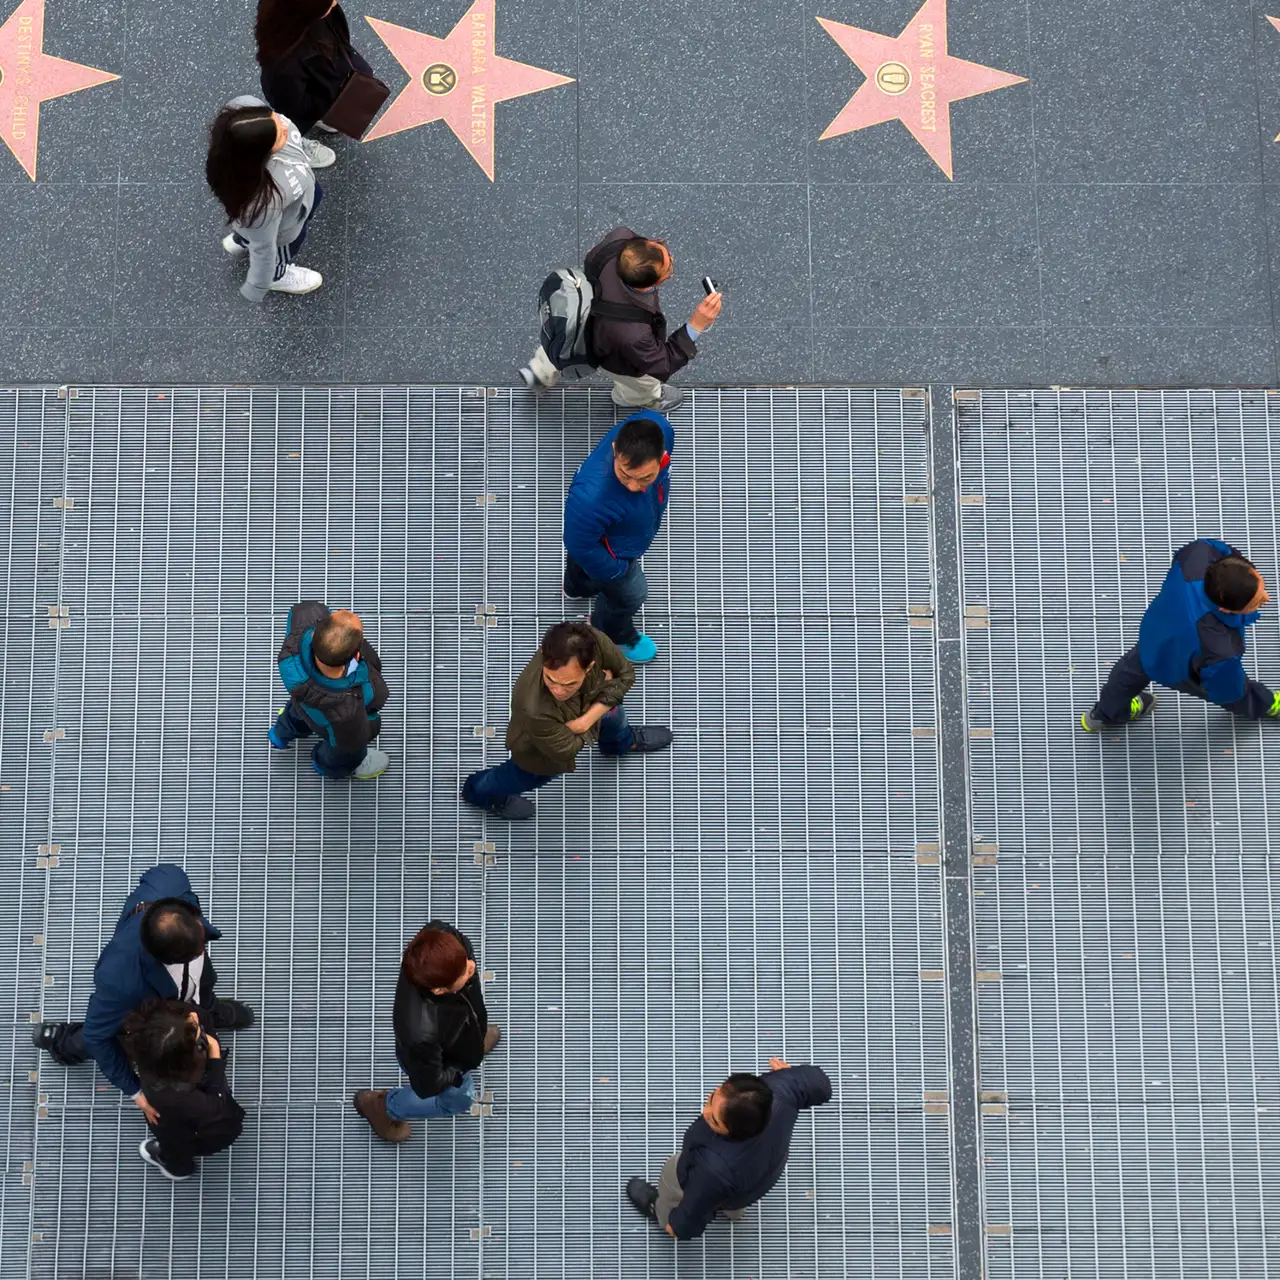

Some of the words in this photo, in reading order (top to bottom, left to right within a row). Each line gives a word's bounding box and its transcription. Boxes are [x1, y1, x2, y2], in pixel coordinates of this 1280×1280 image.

[471, 13, 487, 75] BARBARA
[918, 24, 934, 58] RYAN
[12, 96, 29, 140] CHILD
[471, 86, 487, 144] WALTERS
[919, 67, 936, 132] SEACREST
